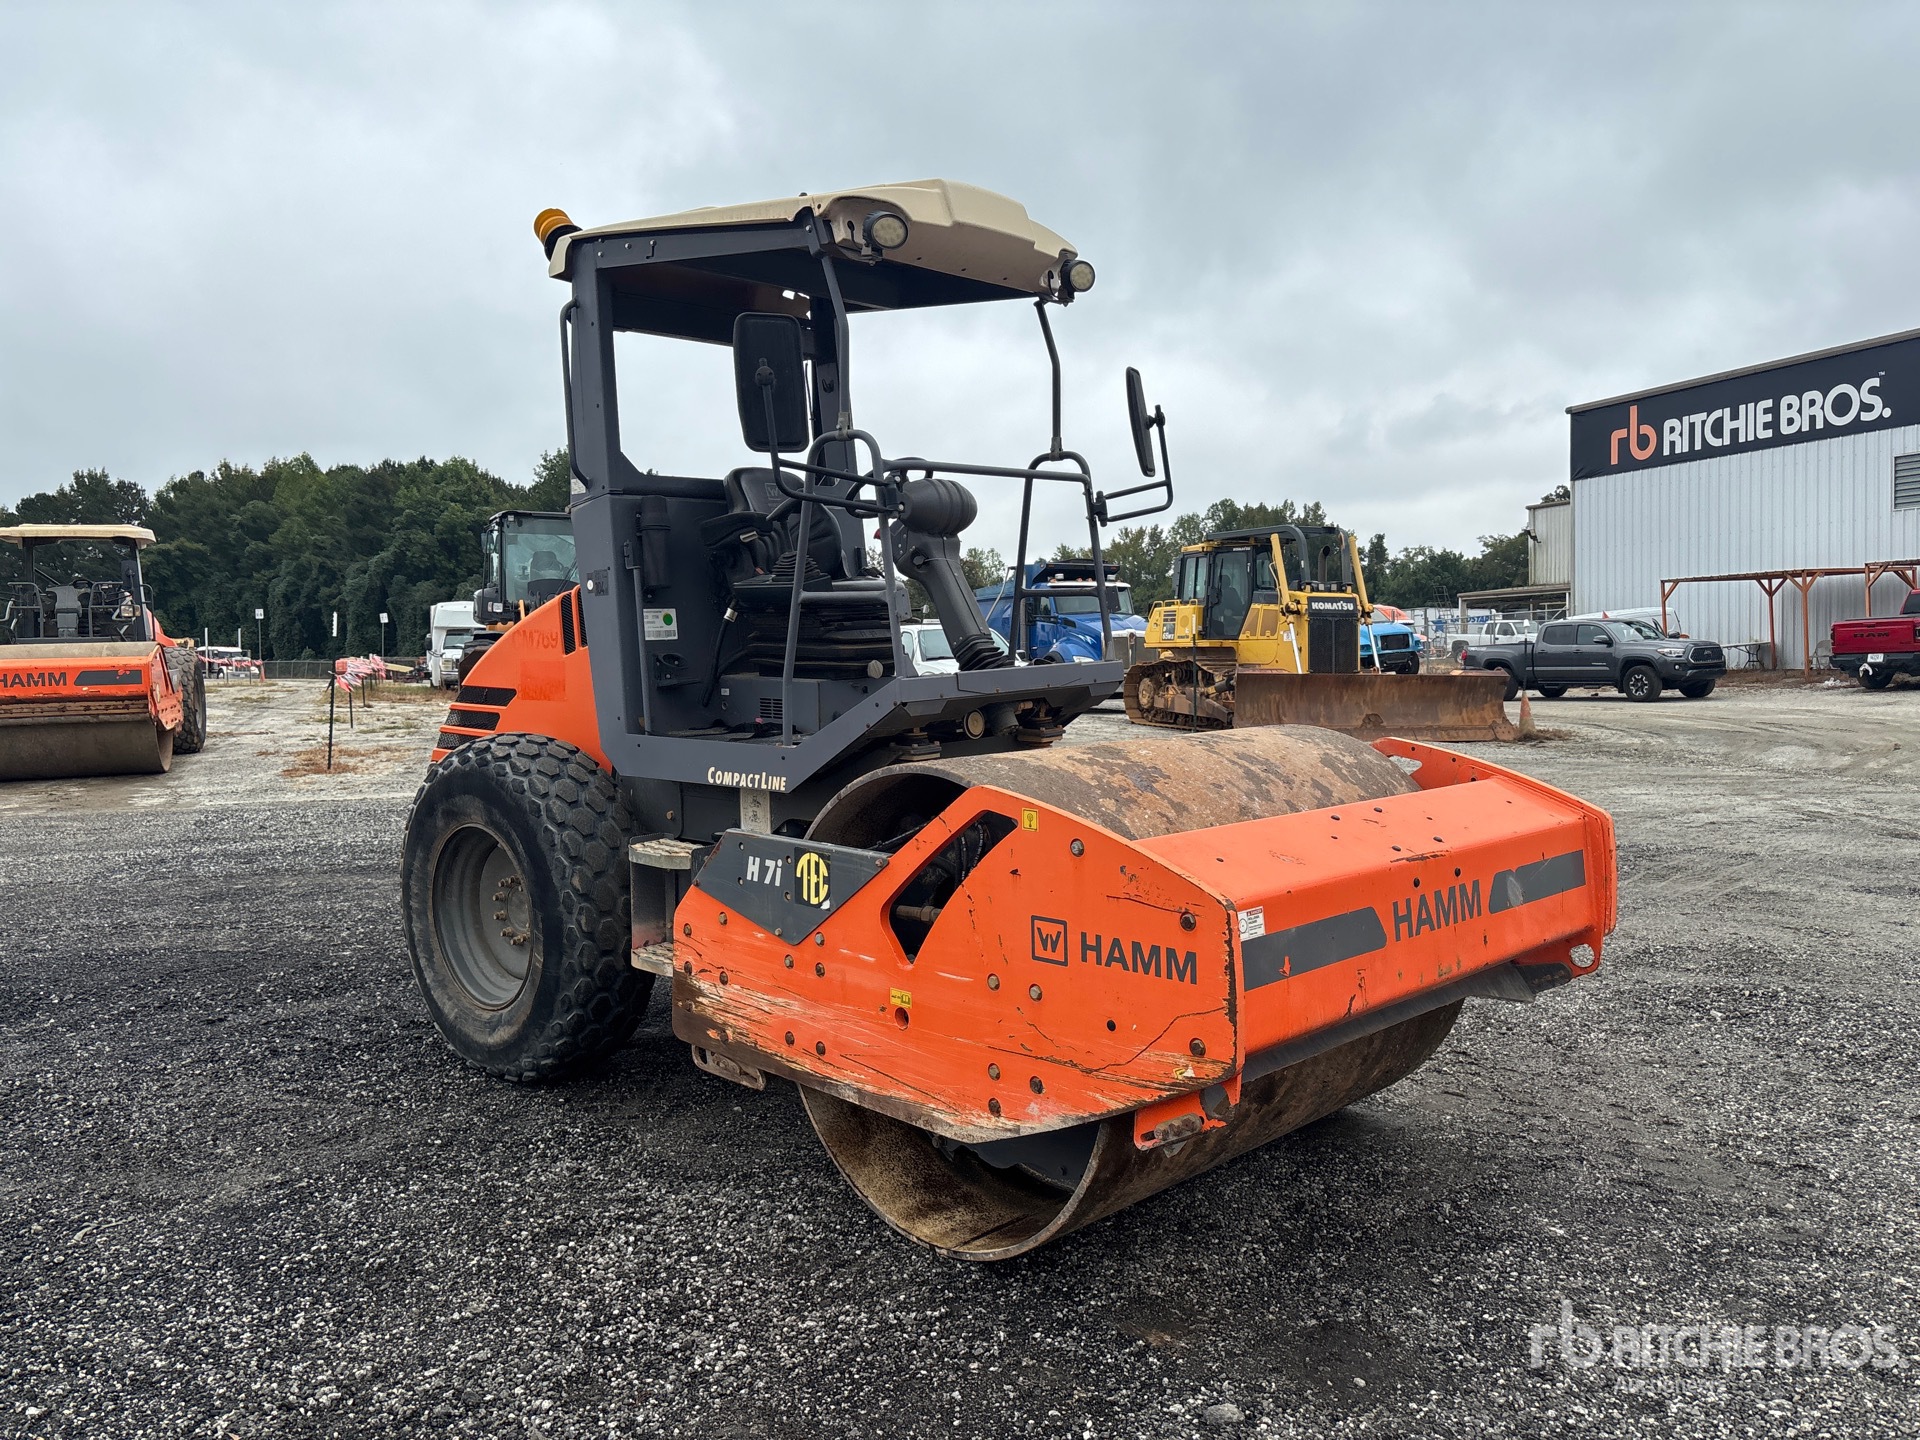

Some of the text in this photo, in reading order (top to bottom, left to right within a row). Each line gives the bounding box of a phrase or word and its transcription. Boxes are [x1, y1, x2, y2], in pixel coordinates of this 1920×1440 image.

[1610, 405, 1658, 465] rb
[1662, 398, 1774, 456] RITCHIE
[1780, 377, 1892, 436] BROS.
[1311, 601, 1354, 611] KOMATSU
[746, 855, 783, 887] H 7i
[1392, 879, 1482, 942] HAMM
[1080, 931, 1198, 985] HAMM
